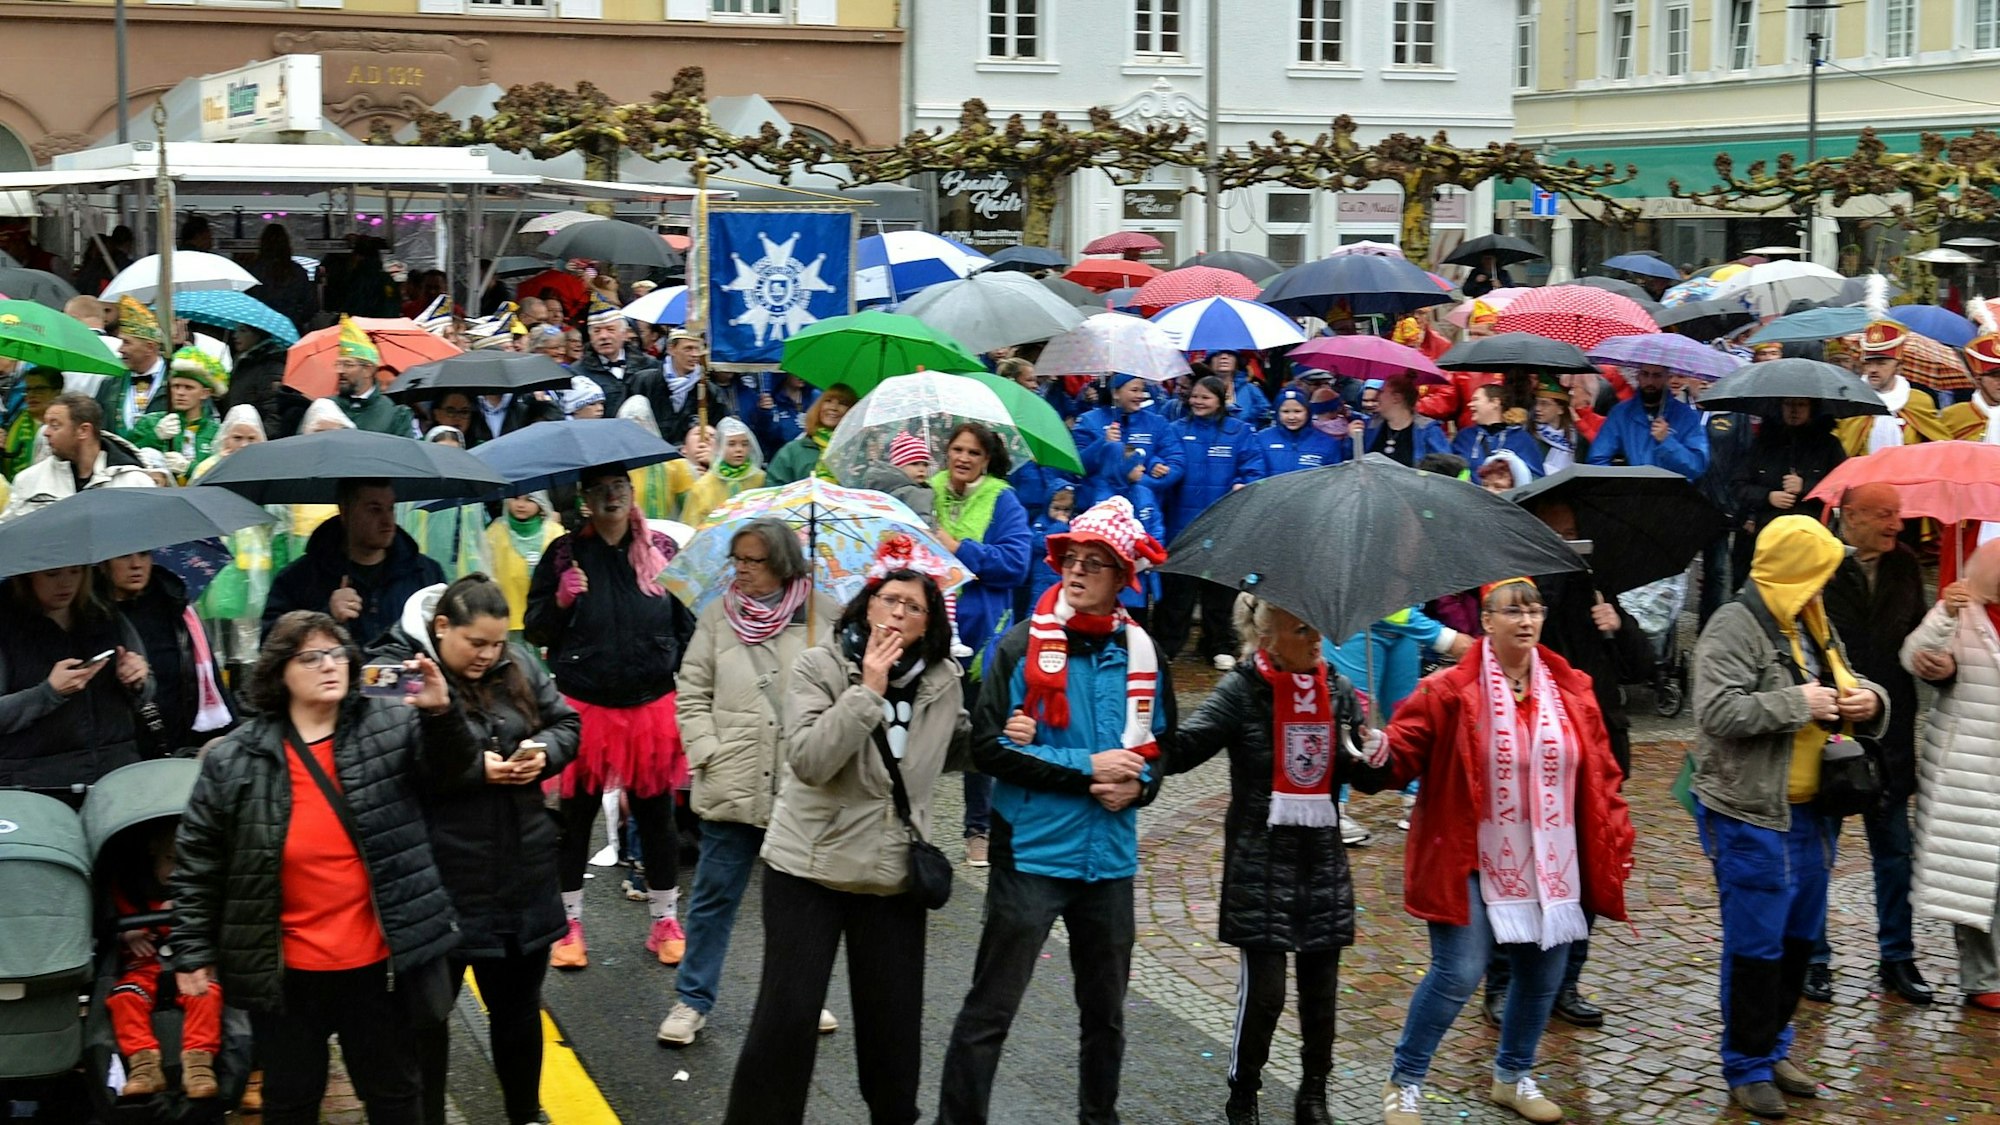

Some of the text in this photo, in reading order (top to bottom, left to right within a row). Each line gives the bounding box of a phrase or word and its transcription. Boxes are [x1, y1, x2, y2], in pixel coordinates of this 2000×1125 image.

[940, 169, 1013, 198] Beauty
[969, 191, 1025, 220] Nails
[1496, 786, 1517, 827] e.V.
[1544, 792, 1561, 832] e.V.
